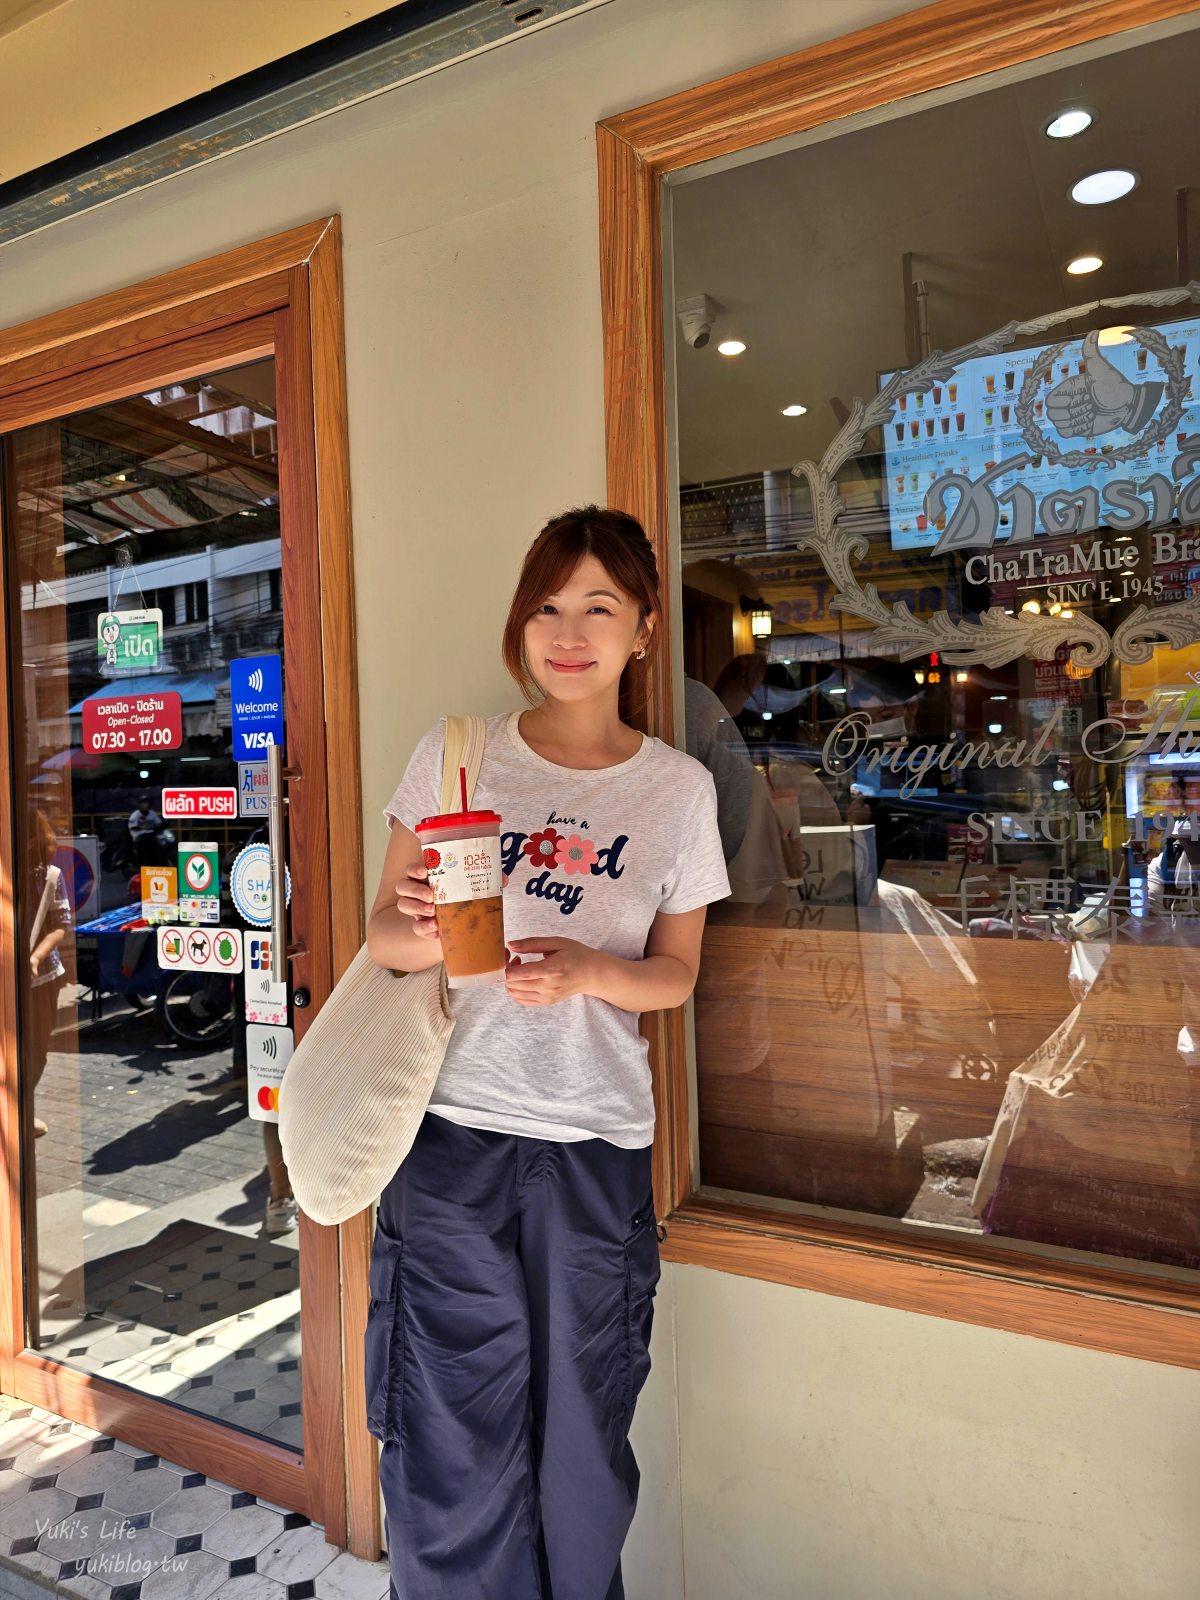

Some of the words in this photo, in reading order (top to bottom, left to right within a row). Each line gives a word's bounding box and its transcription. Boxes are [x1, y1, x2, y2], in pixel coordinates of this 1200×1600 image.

[965, 541, 1140, 585] ChaTraMue
[1046, 579, 1113, 604] SINCE
[1121, 576, 1165, 599] 1945
[124, 634, 154, 657] เปิด
[97, 702, 129, 716] เวลาเปิด
[136, 698, 164, 712] ปิดร้าน
[235, 701, 279, 714] Welcome
[92, 731, 126, 750] 07.30
[138, 728, 172, 747] 17.00
[241, 732, 275, 749] VISA
[822, 706, 1065, 800] Original
[166, 793, 195, 813] ผลัก
[198, 796, 234, 813] PUSH
[246, 797, 268, 811] PUS
[546, 811, 577, 826] have
[580, 820, 590, 830] a
[967, 811, 1102, 843] SINCE
[525, 870, 585, 915] day
